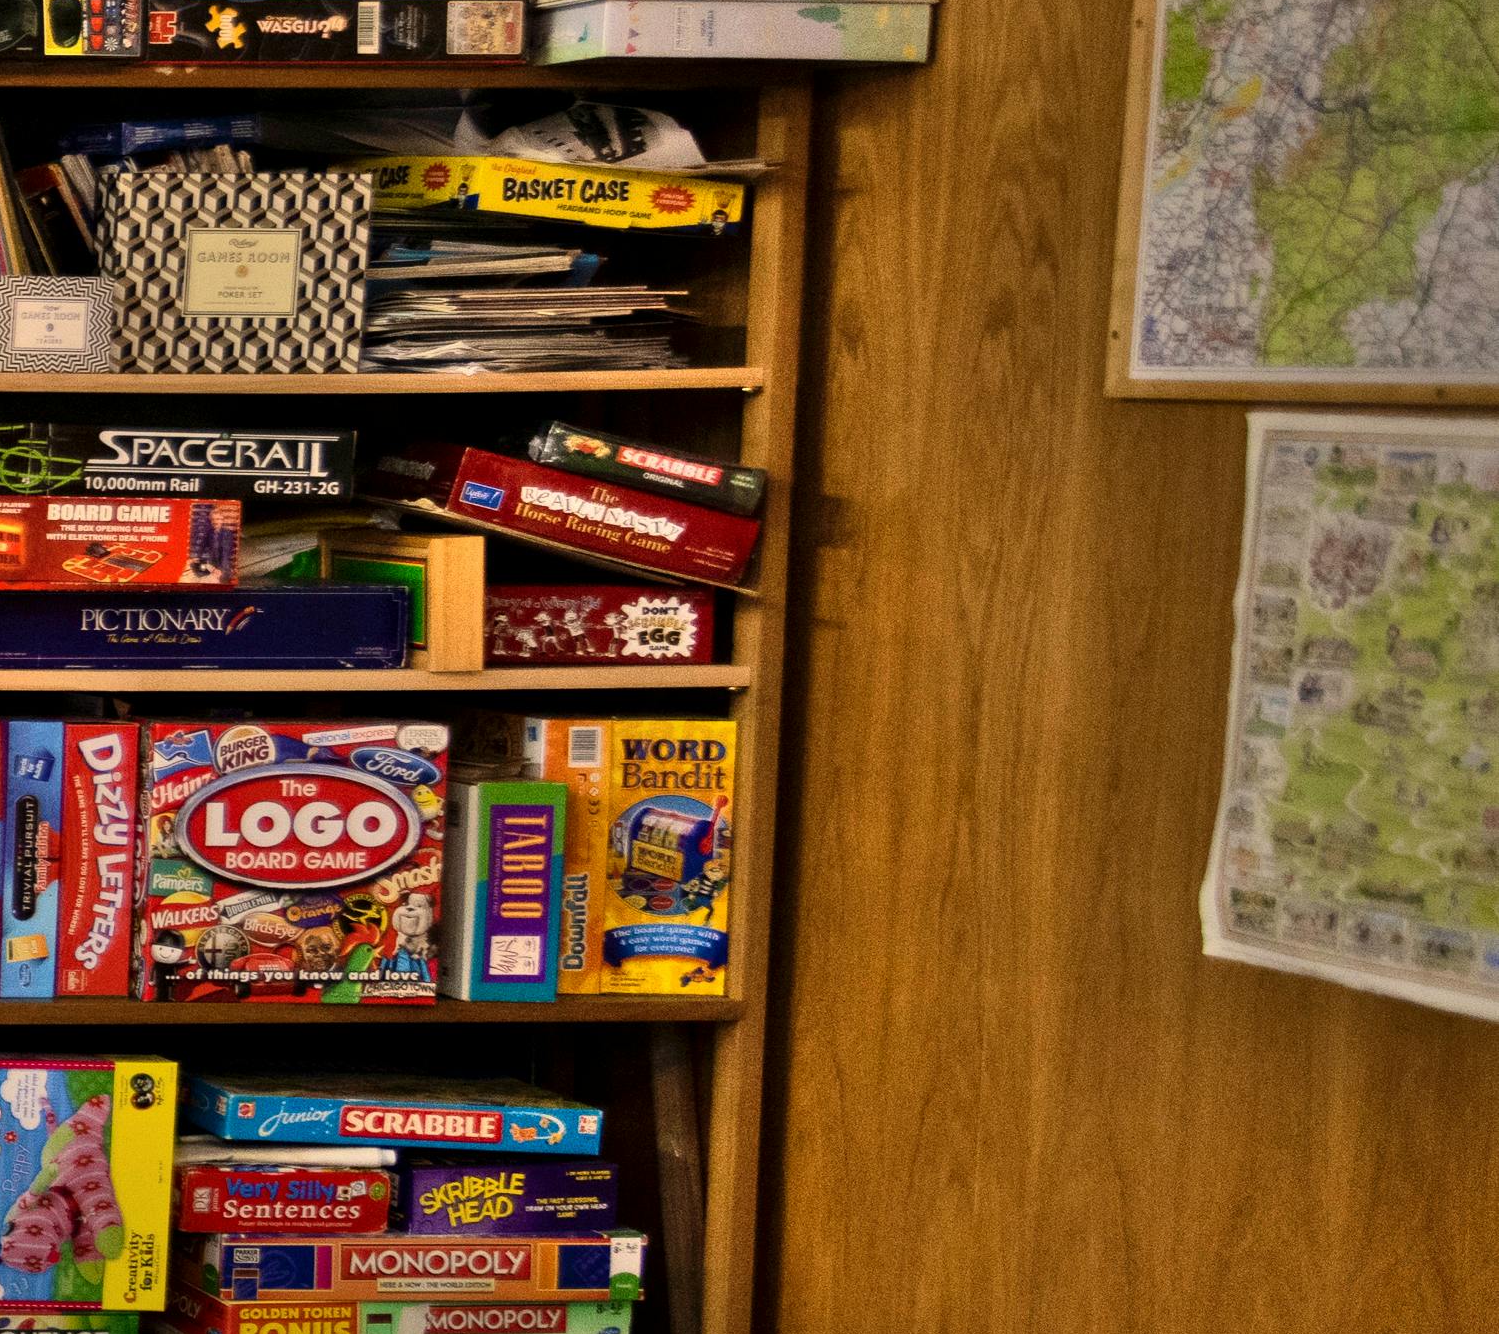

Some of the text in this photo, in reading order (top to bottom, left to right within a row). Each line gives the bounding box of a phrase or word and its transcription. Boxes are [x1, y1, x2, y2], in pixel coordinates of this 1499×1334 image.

[378, 165, 409, 188] CASE
[502, 176, 630, 203] BASKET CASE
[556, 203, 653, 220] HEADBAND HOOP GAME
[196, 252, 291, 264] GAMES ROOM
[217, 290, 263, 299] POKER SET
[87, 429, 331, 478] SPACERAIL
[620, 449, 721, 486] SCRABBLE
[83, 476, 340, 496] 10,000mm Rail GH-231-2G
[642, 472, 685, 489] ORIGINAL
[589, 485, 620, 504] The
[46, 503, 171, 523] BOARD GAME
[46, 533, 169, 543] WITH ELECTRONIC DEAL PHONE
[59, 524, 156, 533] THE BOX OPENING GAME
[514, 502, 672, 554] Horse Racing Game
[80, 608, 229, 632] PICTIONARY
[641, 606, 679, 616] DON'T
[638, 628, 681, 646] EGG
[219, 734, 268, 758] BURGER
[306, 727, 398, 744] national express
[221, 749, 270, 773] KING
[621, 738, 727, 763] WORD
[365, 752, 421, 782] Ford
[621, 762, 726, 790] Bandit
[279, 779, 318, 797] The
[205, 801, 398, 848] LOGO
[21, 801, 36, 912] TRIVIAL PURSUIT
[225, 852, 367, 870] BOARD GAME
[500, 814, 548, 919] TABOO
[152, 873, 205, 892] Pampers
[74, 852, 128, 971] LETTERS
[151, 904, 220, 929] WALKERS
[225, 892, 276, 917] DOUBLEMINT
[286, 903, 342, 922] Orange
[562, 872, 589, 971] Downfall
[612, 925, 720, 941] The board game with
[186, 969, 202, 980] of
[208, 969, 258, 982] things
[264, 970, 293, 982] you
[299, 969, 341, 980] know
[349, 970, 378, 980] and
[385, 969, 420, 980] love
[257, 1106, 498, 1140] junior SCRABBLE
[1, 1143, 32, 1195] Poppy
[226, 1177, 336, 1203] Very Silly
[419, 1171, 526, 1214] SKRIBBLE
[222, 1199, 361, 1219] Sentences
[447, 1195, 514, 1227] HEAD
[138, 1232, 155, 1292] for Kids
[234, 1248, 259, 1256] PARKER
[349, 1250, 526, 1278] MONOPOLY
[123, 1231, 143, 1304] Creativity
[238, 1307, 352, 1322] GOLDEN TOKEN
[428, 1307, 563, 1331] MONOPOLY
